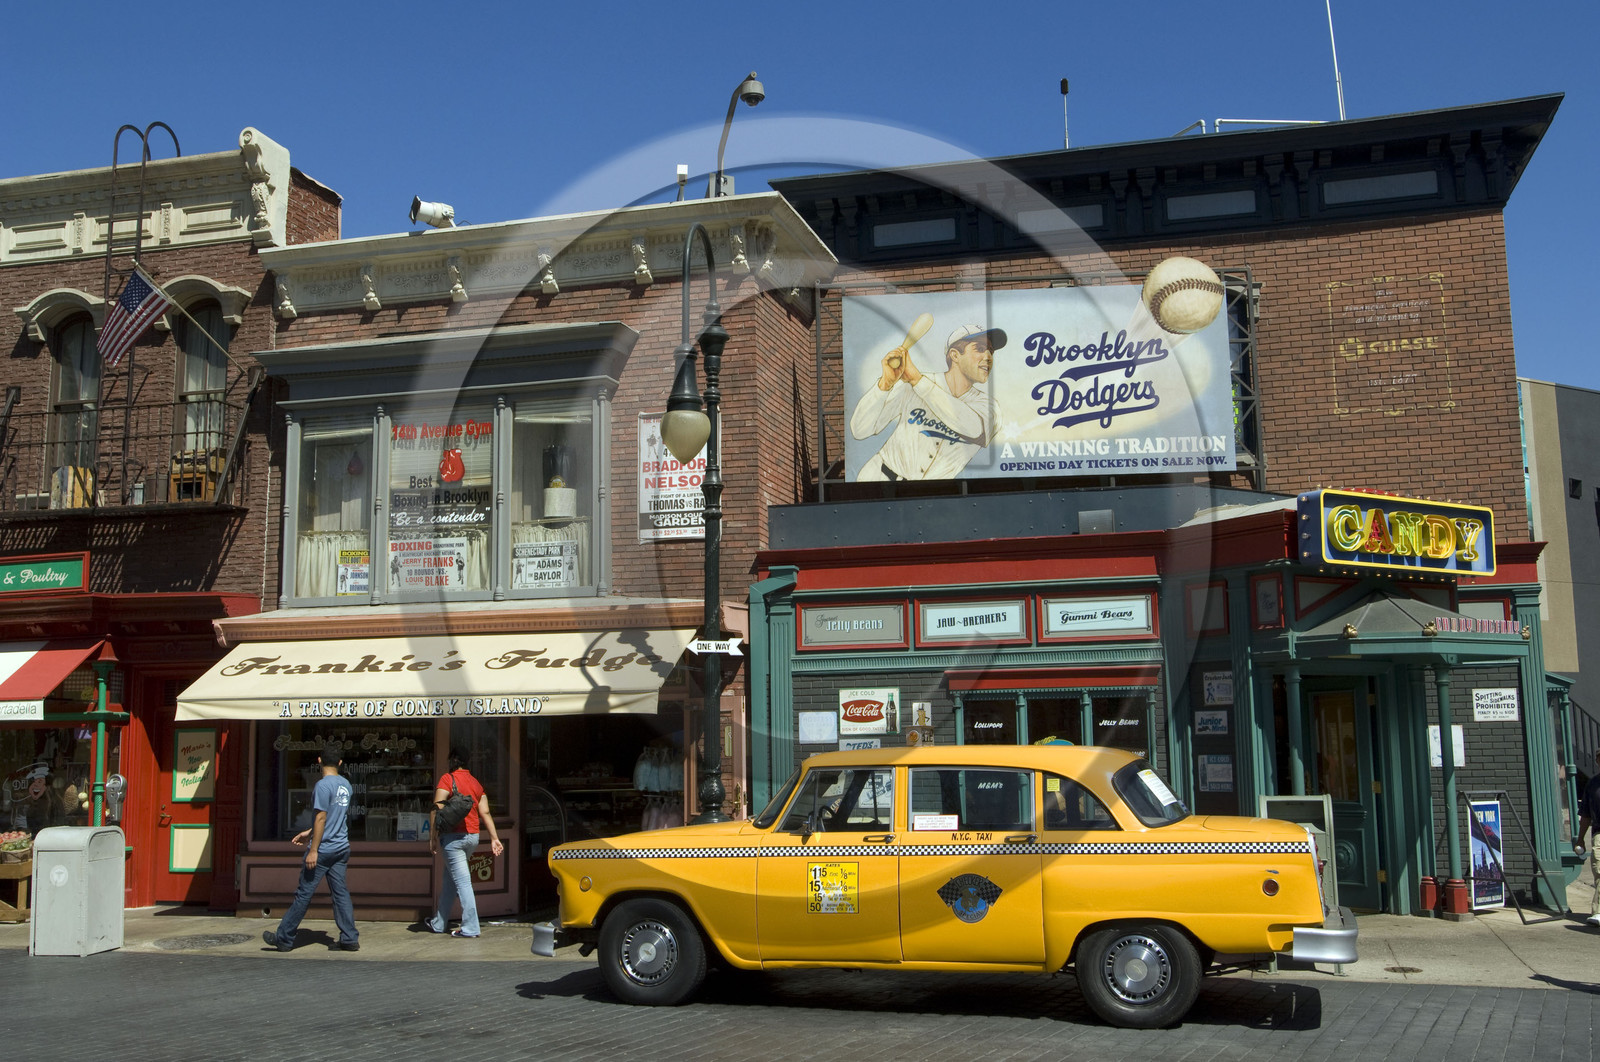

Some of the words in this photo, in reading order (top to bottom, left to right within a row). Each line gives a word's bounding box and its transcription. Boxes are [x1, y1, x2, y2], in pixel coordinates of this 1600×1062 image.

[1369, 336, 1438, 352] CHASE
[1023, 329, 1169, 380] Brooklyn
[1031, 376, 1160, 429] Dodgers
[392, 424, 417, 440] 14th
[420, 422, 463, 439] Avenue
[466, 419, 492, 439] Gym
[1000, 442, 1015, 458] A
[1019, 439, 1110, 458] WINNING
[1115, 435, 1226, 455] TRADITION
[642, 458, 706, 473] BRADFOR
[1000, 461, 1055, 472] OPENING
[1058, 460, 1083, 470] DAY
[1086, 458, 1138, 469] TICKETS
[1141, 457, 1159, 467] ON
[1162, 456, 1193, 466] SALE
[1196, 455, 1227, 466] NOW.
[409, 475, 432, 488] Best
[644, 475, 706, 489] NELSO
[394, 494, 428, 508] Boxing
[431, 491, 440, 504] in
[443, 489, 489, 505] Brooklyn
[648, 499, 685, 510] THOMAS
[693, 498, 706, 508] RA
[416, 515, 424, 524] a
[653, 517, 706, 527] GARDEN
[1327, 504, 1483, 562] CANDY
[391, 541, 432, 552] BOXING
[548, 545, 561, 555] PARK
[423, 556, 454, 568] FRANKS
[536, 559, 562, 569] ADAMS
[3, 572, 16, 584] &
[20, 568, 69, 586] Poultry
[414, 568, 434, 576] ROUNDS
[534, 571, 561, 580] BAYLOR
[425, 575, 449, 586] BLAKE
[1061, 611, 1097, 624] Gummi
[1100, 609, 1133, 619] Bears
[825, 619, 851, 633] Jelly
[853, 619, 884, 630] Beans
[1435, 617, 1472, 632] CANDY
[715, 642, 731, 650] WAY
[220, 650, 466, 677] Frankie's
[484, 648, 663, 673] Fudge
[1475, 691, 1502, 701] SPITTING
[1489, 694, 1515, 703] SIDEWALKS
[0, 703, 37, 715] rtadella
[299, 701, 358, 718] TASTE
[363, 700, 387, 717] OF
[392, 698, 459, 717] CONEY
[846, 703, 881, 717] Coca-Cola
[974, 721, 1003, 729] LOLLIPOPS
[1118, 718, 1140, 726] BEANS
[1198, 716, 1222, 726] Junior
[181, 741, 211, 756] Mario's
[360, 732, 417, 753] Fudge
[1484, 810, 1496, 822] YORK
[951, 832, 972, 841] N.Y.C.
[976, 832, 993, 841] TAXI
[470, 857, 493, 873] PPLES
